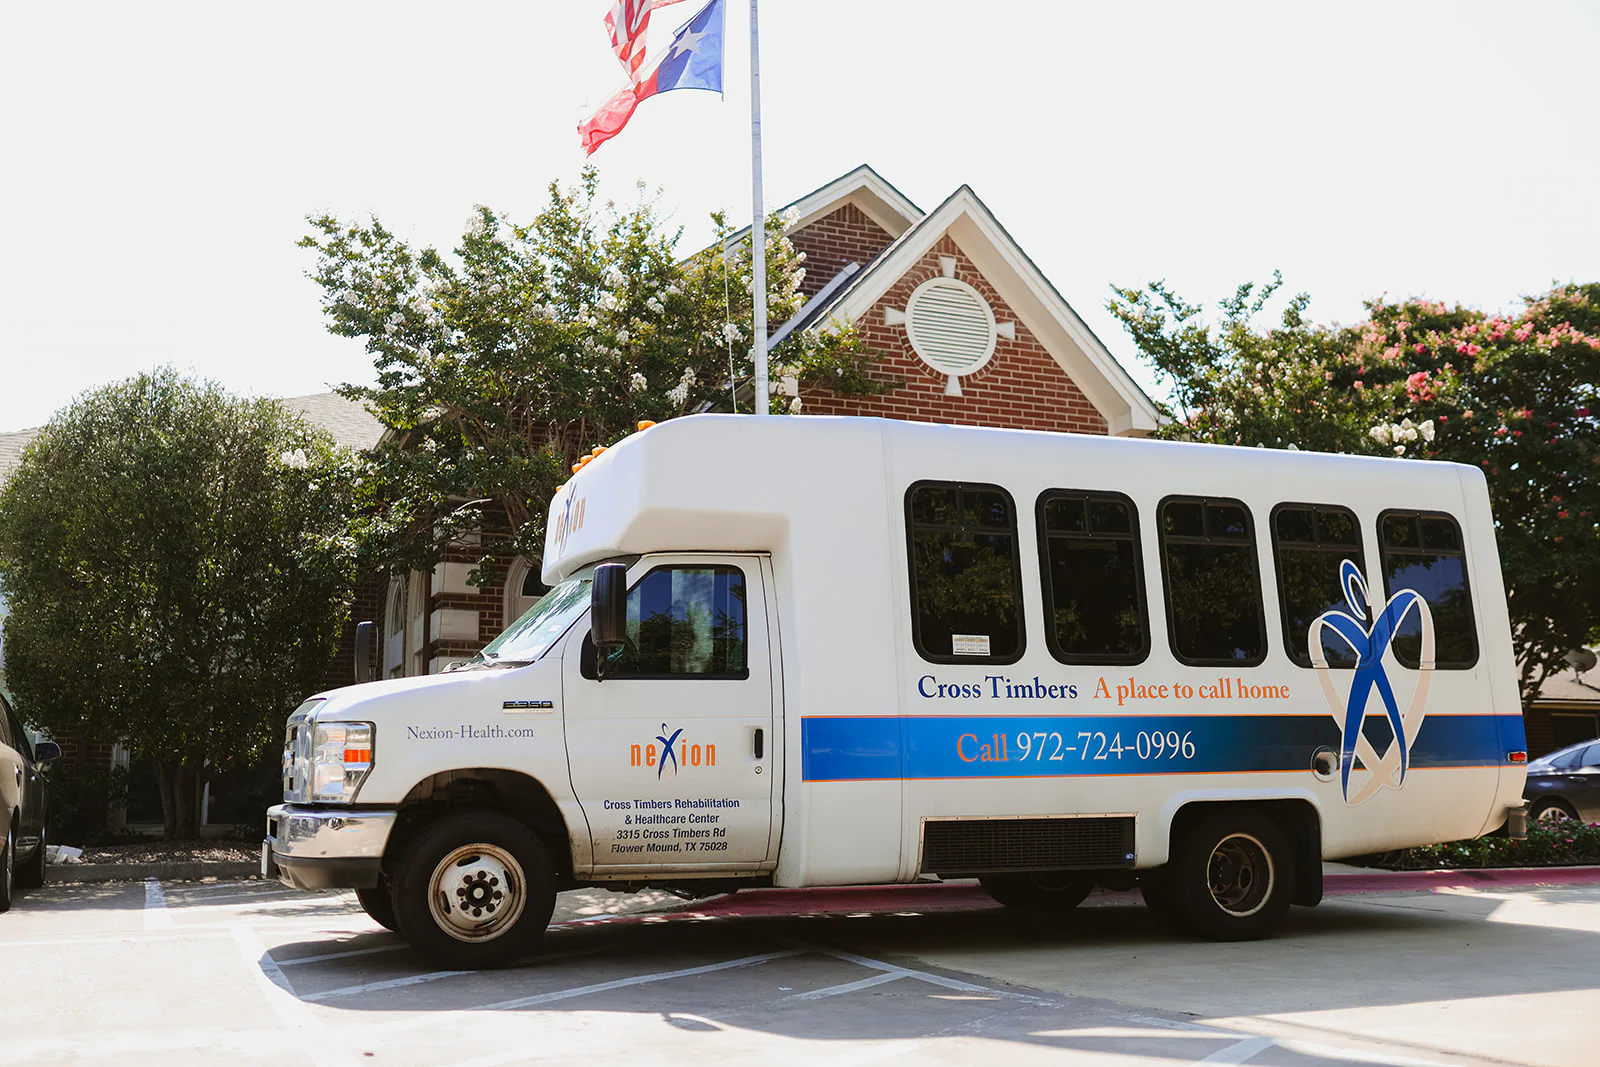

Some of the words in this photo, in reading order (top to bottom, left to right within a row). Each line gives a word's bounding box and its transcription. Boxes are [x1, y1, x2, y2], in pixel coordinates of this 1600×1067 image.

[918, 675, 982, 699] Cross
[984, 675, 1078, 699] Timbers
[1093, 676, 1112, 699] A
[1116, 677, 1169, 706] place
[1173, 682, 1194, 699] to
[1199, 677, 1233, 699] call
[1236, 678, 1290, 699] home
[407, 725, 534, 740] Nexion-Health.com
[957, 733, 1009, 762] Call
[1016, 730, 1196, 761] 972-724-0996
[603, 800, 631, 810] Cross
[633, 799, 672, 809] Timbers
[674, 798, 740, 809] Rehabilitation
[624, 815, 632, 825] &
[634, 814, 686, 825] Healthcare
[688, 813, 720, 824] Center
[616, 829, 640, 840] 3315
[642, 829, 670, 839] Cross
[672, 828, 710, 838] Timbers
[712, 827, 726, 837] Rd
[611, 843, 644, 854] Flower
[646, 843, 682, 853] Mound,
[684, 842, 697, 852] TX
[699, 841, 728, 851] 75028
